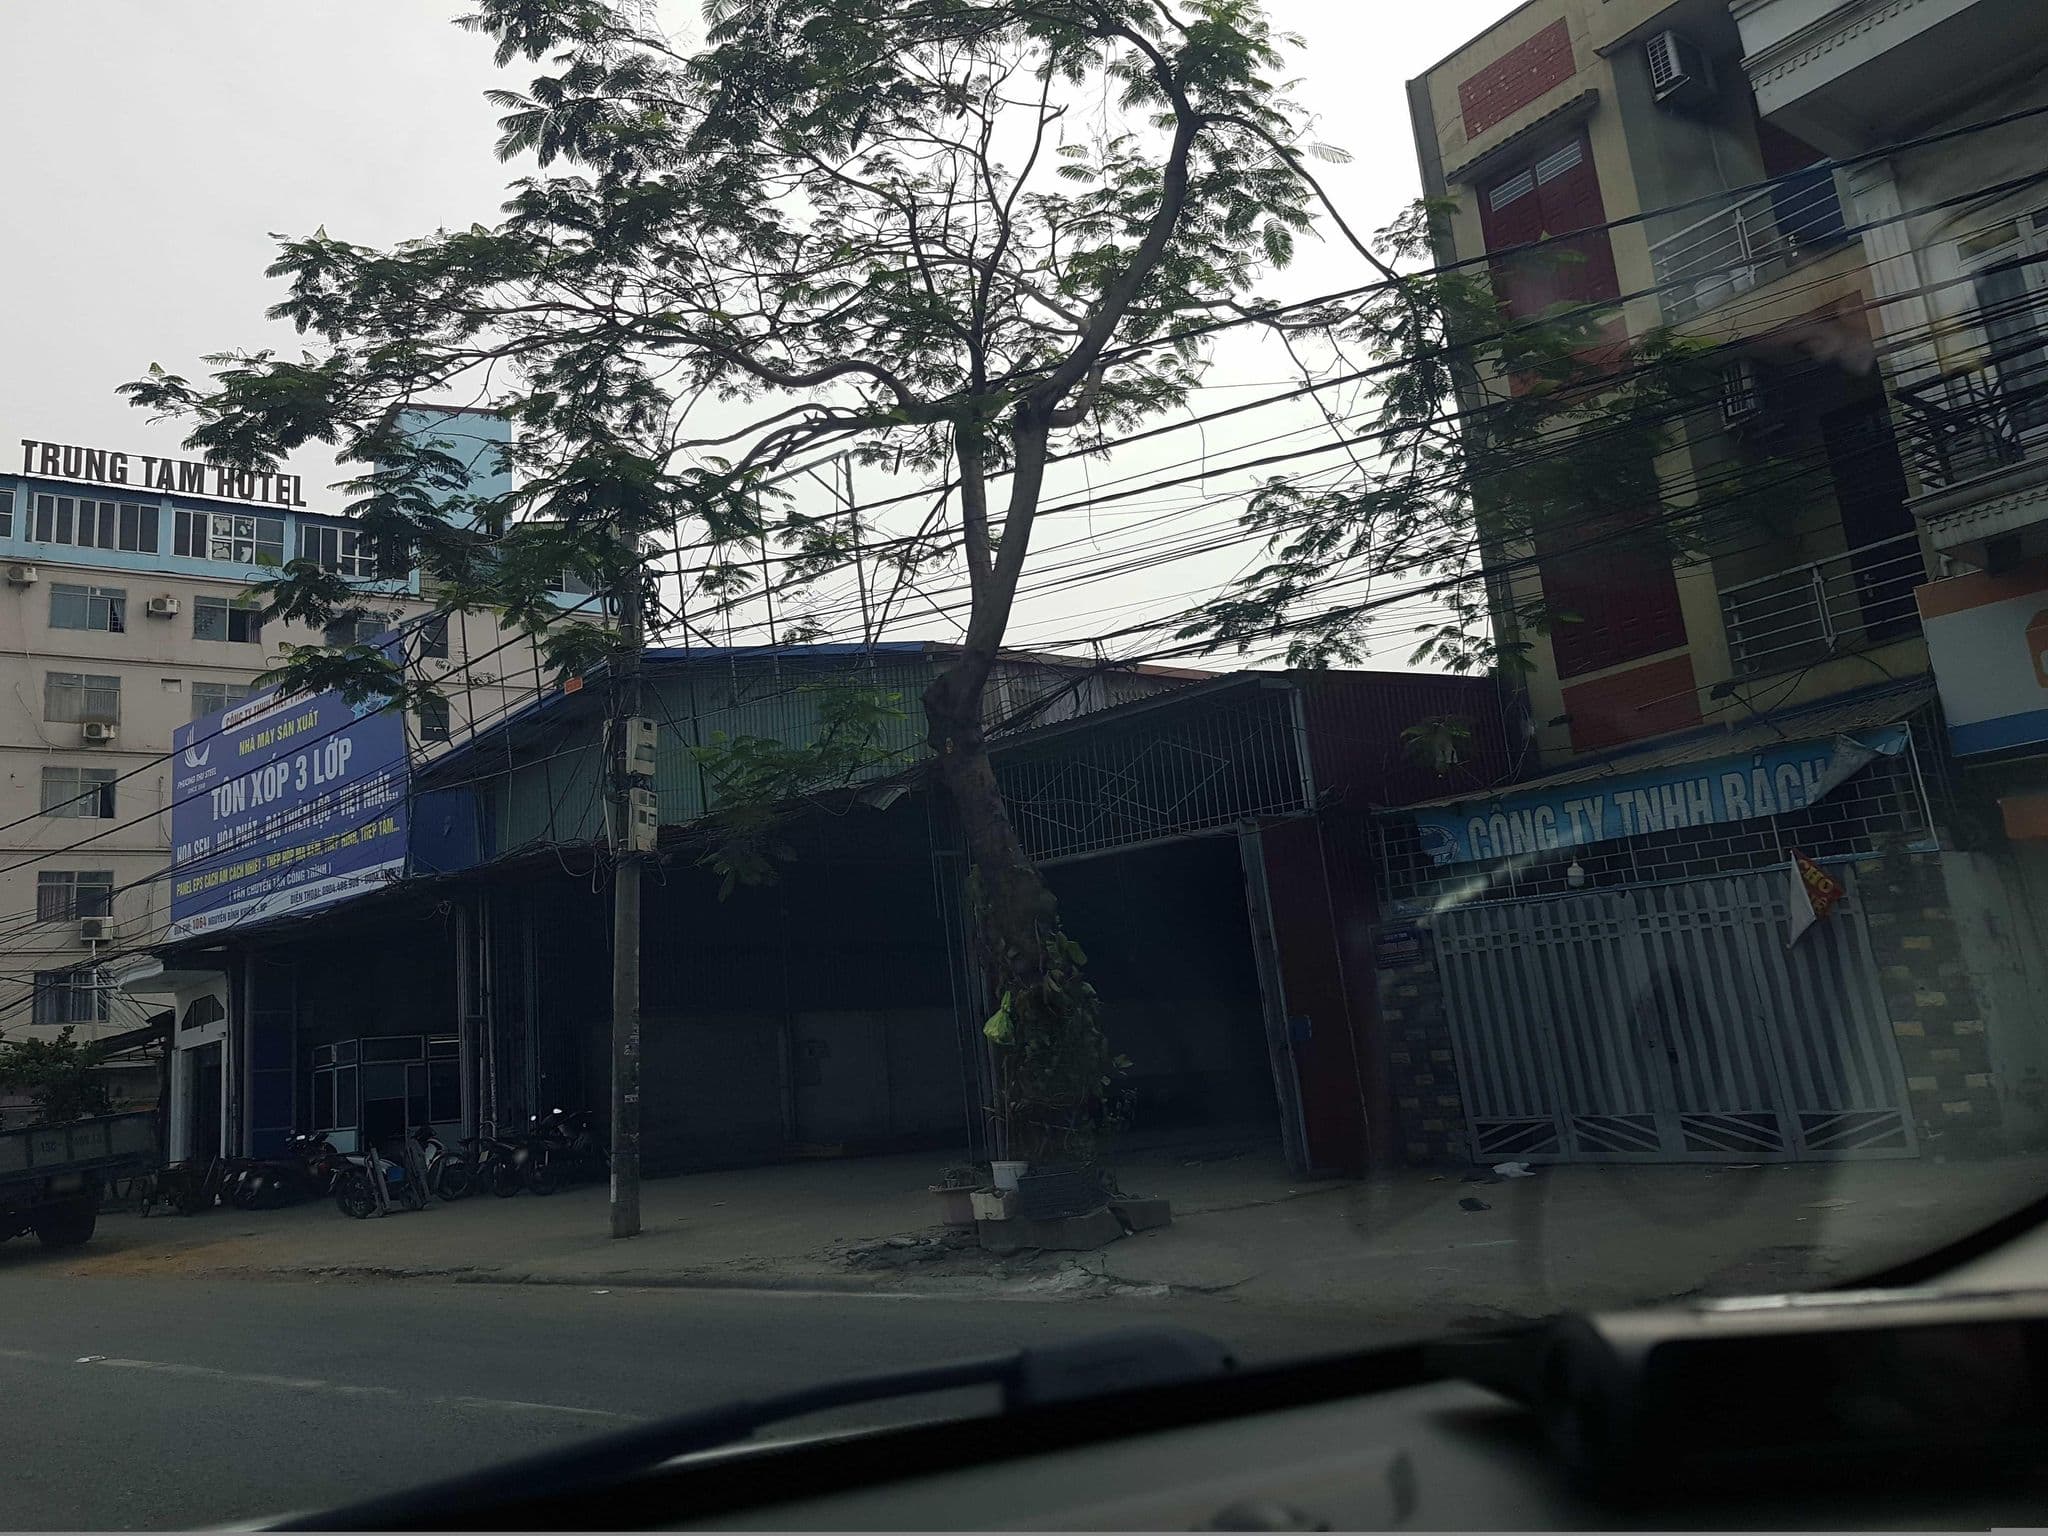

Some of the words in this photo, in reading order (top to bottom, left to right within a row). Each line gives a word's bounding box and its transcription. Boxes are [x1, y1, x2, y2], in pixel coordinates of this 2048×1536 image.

[21, 439, 128, 485] TRUNG
[142, 455, 205, 495] TAM
[216, 465, 307, 508] HOTEL
[239, 734, 256, 757] NHÀ
[257, 727, 275, 751] MÁY
[277, 718, 294, 742] SẢN
[296, 706, 319, 734] XUẤT
[211, 776, 246, 821] TÔN
[251, 752, 289, 808] XỐP
[295, 755, 308, 791] 3
[314, 735, 352, 785] LỚP
[1466, 799, 1559, 862] CÔNG
[1563, 795, 1605, 846] TY
[1613, 776, 1715, 837] TNHH
[287, 870, 305, 886] CÔNG
